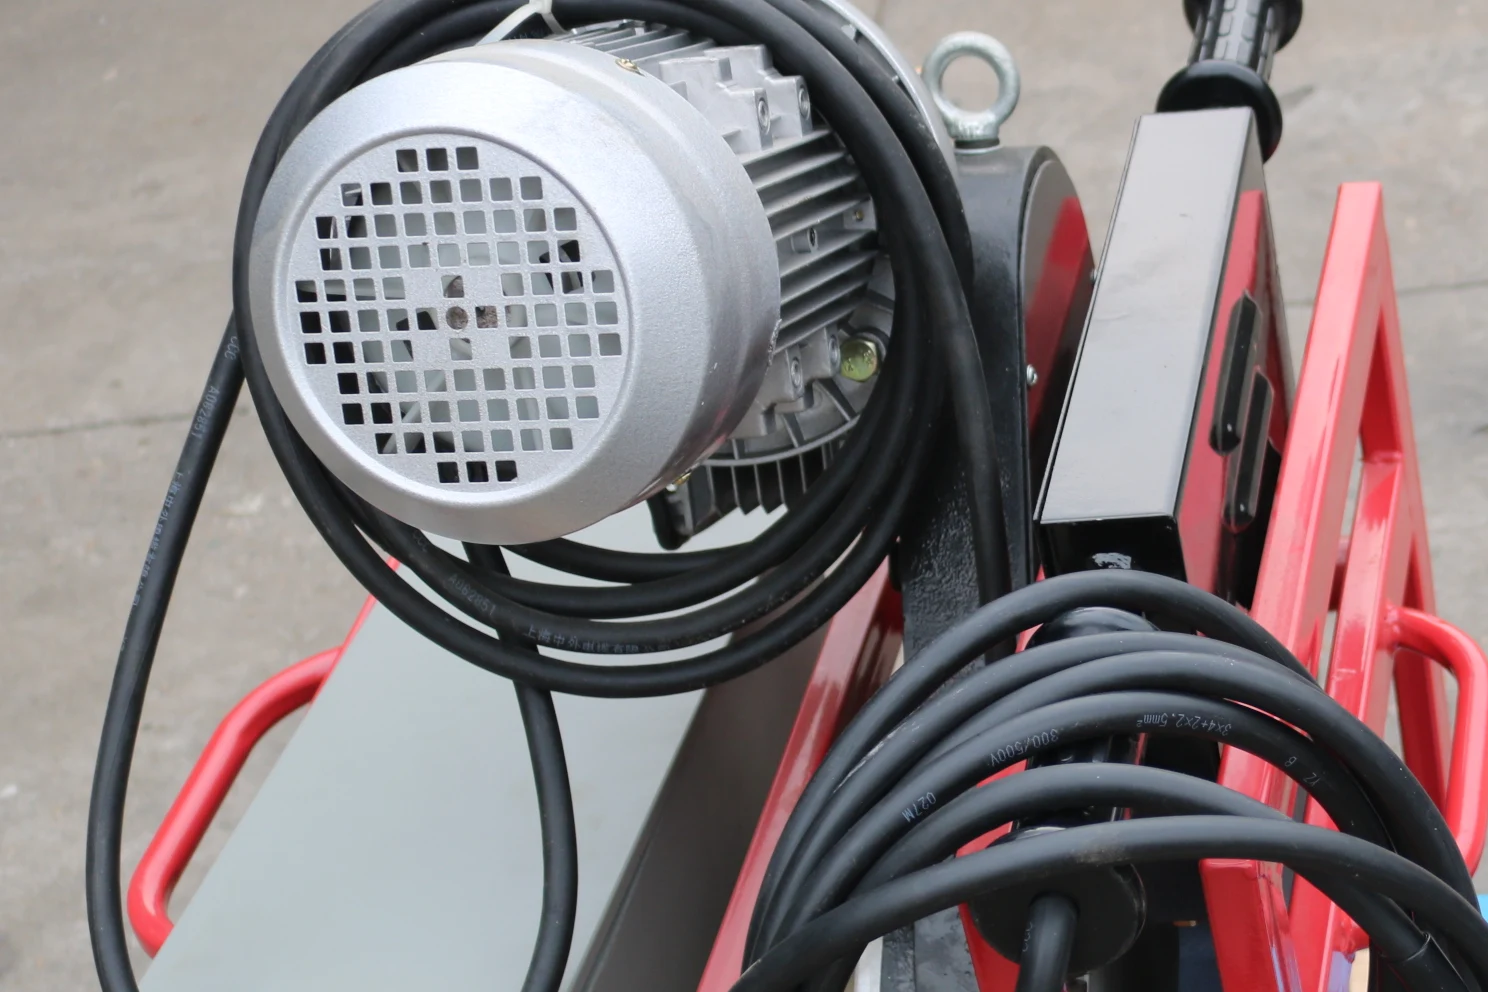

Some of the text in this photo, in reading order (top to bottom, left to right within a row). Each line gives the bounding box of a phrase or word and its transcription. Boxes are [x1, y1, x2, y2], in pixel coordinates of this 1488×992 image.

[447, 572, 496, 617] A062851
[988, 728, 1060, 768] 300/500V
[902, 791, 936, 823] 027M
